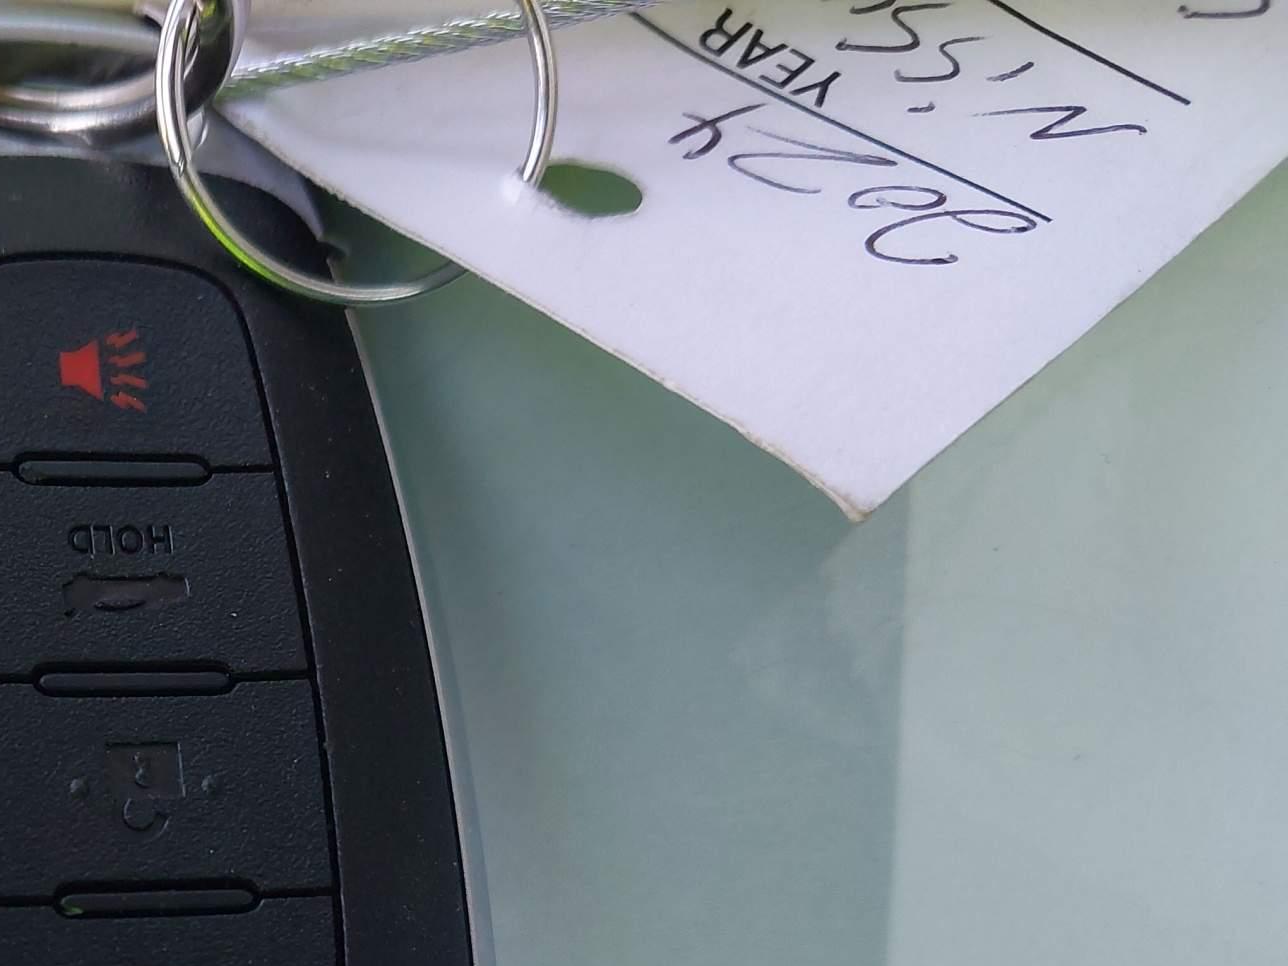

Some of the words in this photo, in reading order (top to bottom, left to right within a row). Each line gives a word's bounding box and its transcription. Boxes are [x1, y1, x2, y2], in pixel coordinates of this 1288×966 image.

[698, 8, 843, 108] YEAR
[667, 102, 1038, 266] 2024
[68, 523, 175, 556] HOLD
